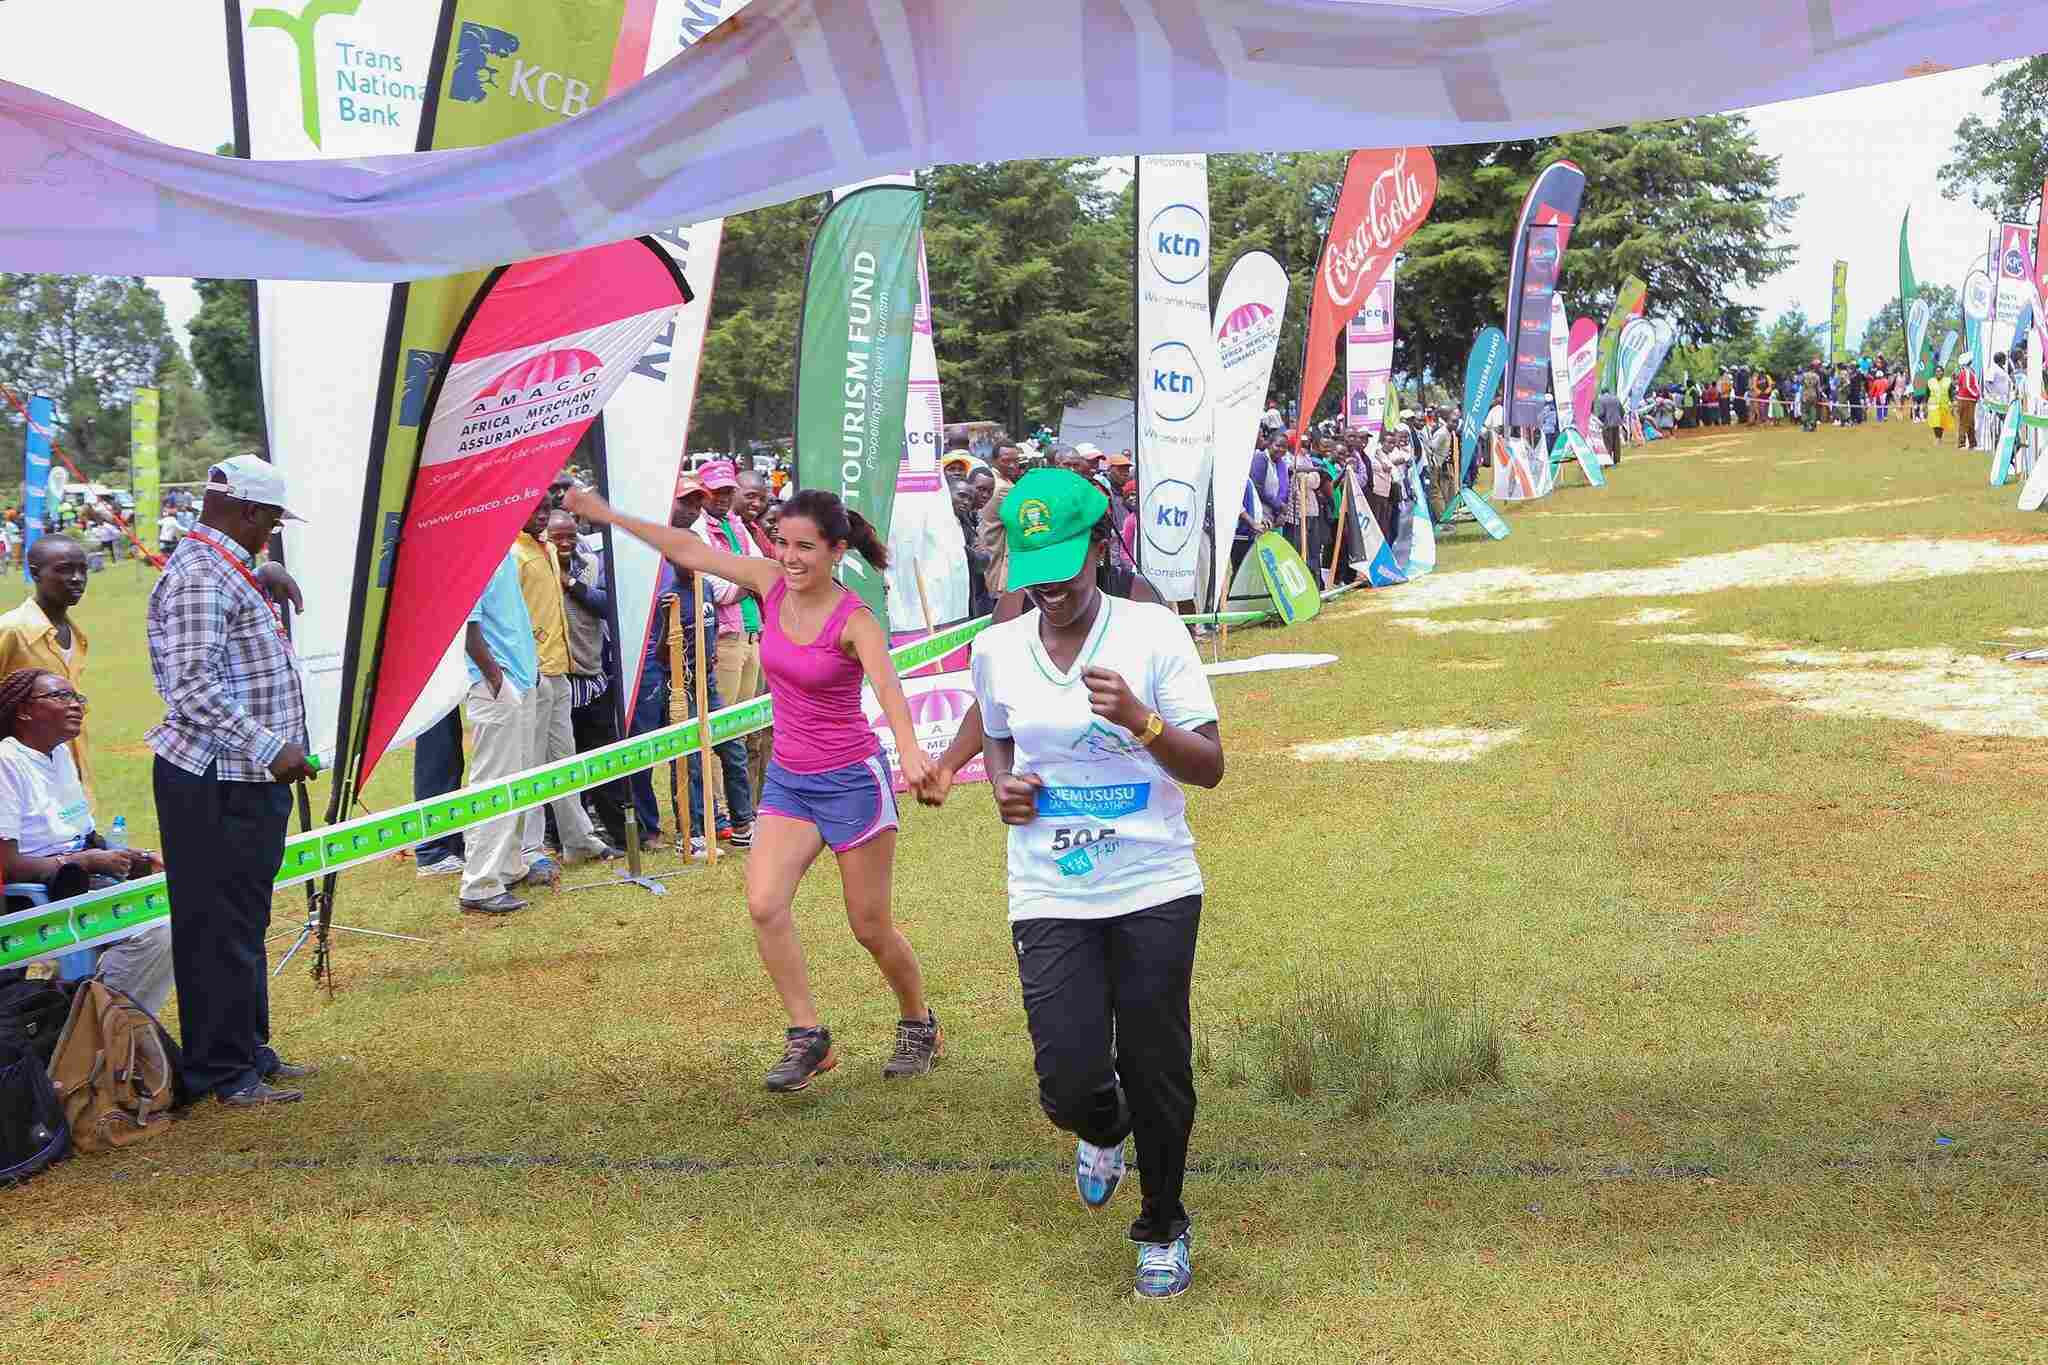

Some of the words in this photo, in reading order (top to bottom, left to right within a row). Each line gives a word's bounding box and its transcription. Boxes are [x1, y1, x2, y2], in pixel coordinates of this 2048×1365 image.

[336, 42, 402, 72] Trans
[336, 70, 427, 101] Nationa
[510, 59, 590, 118] KCB
[339, 96, 401, 127] Bank
[1158, 232, 1201, 257] ktn
[848, 251, 876, 343] FUND
[1153, 369, 1194, 394] ktn
[461, 415, 511, 437] AFRICA
[526, 388, 599, 420] MERCHANT
[841, 352, 869, 503] TOURISM
[458, 420, 539, 453] ASSURANCE
